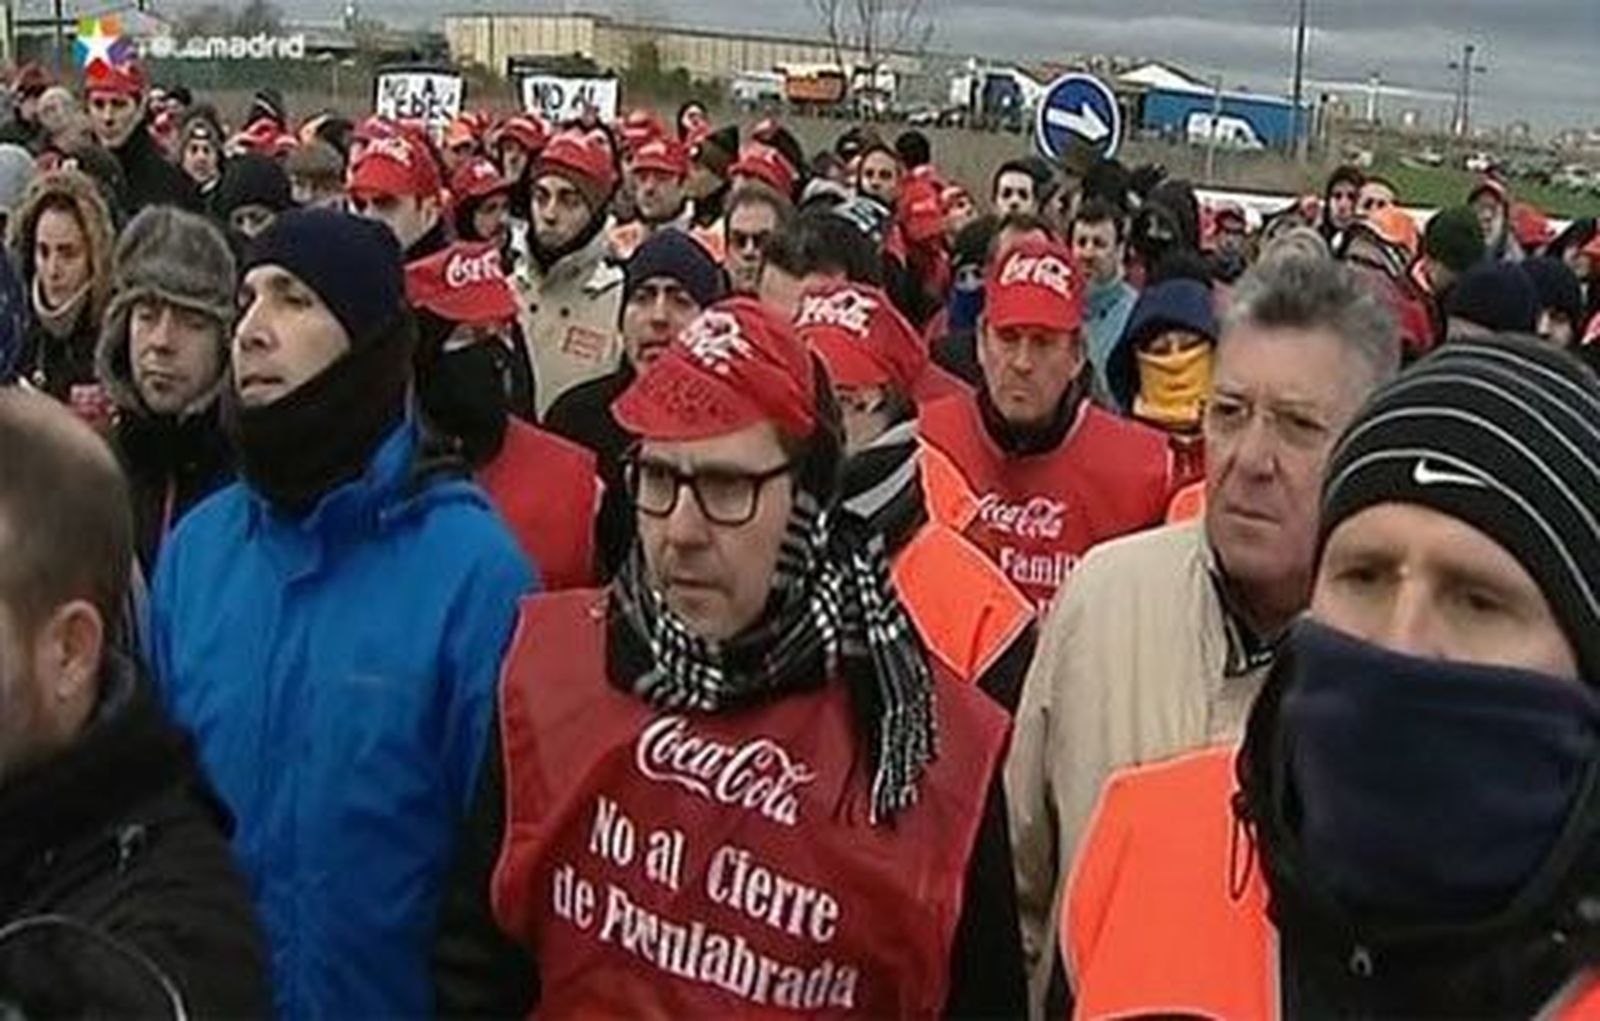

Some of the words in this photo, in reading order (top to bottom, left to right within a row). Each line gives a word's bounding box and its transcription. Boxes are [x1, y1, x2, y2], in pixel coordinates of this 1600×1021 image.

[532, 83, 563, 109] NO
[554, 865, 594, 927] de
[601, 885, 858, 1009] Fuenlabrada
[590, 796, 633, 865] No
[646, 829, 684, 890] al
[707, 845, 839, 942] Cierre
